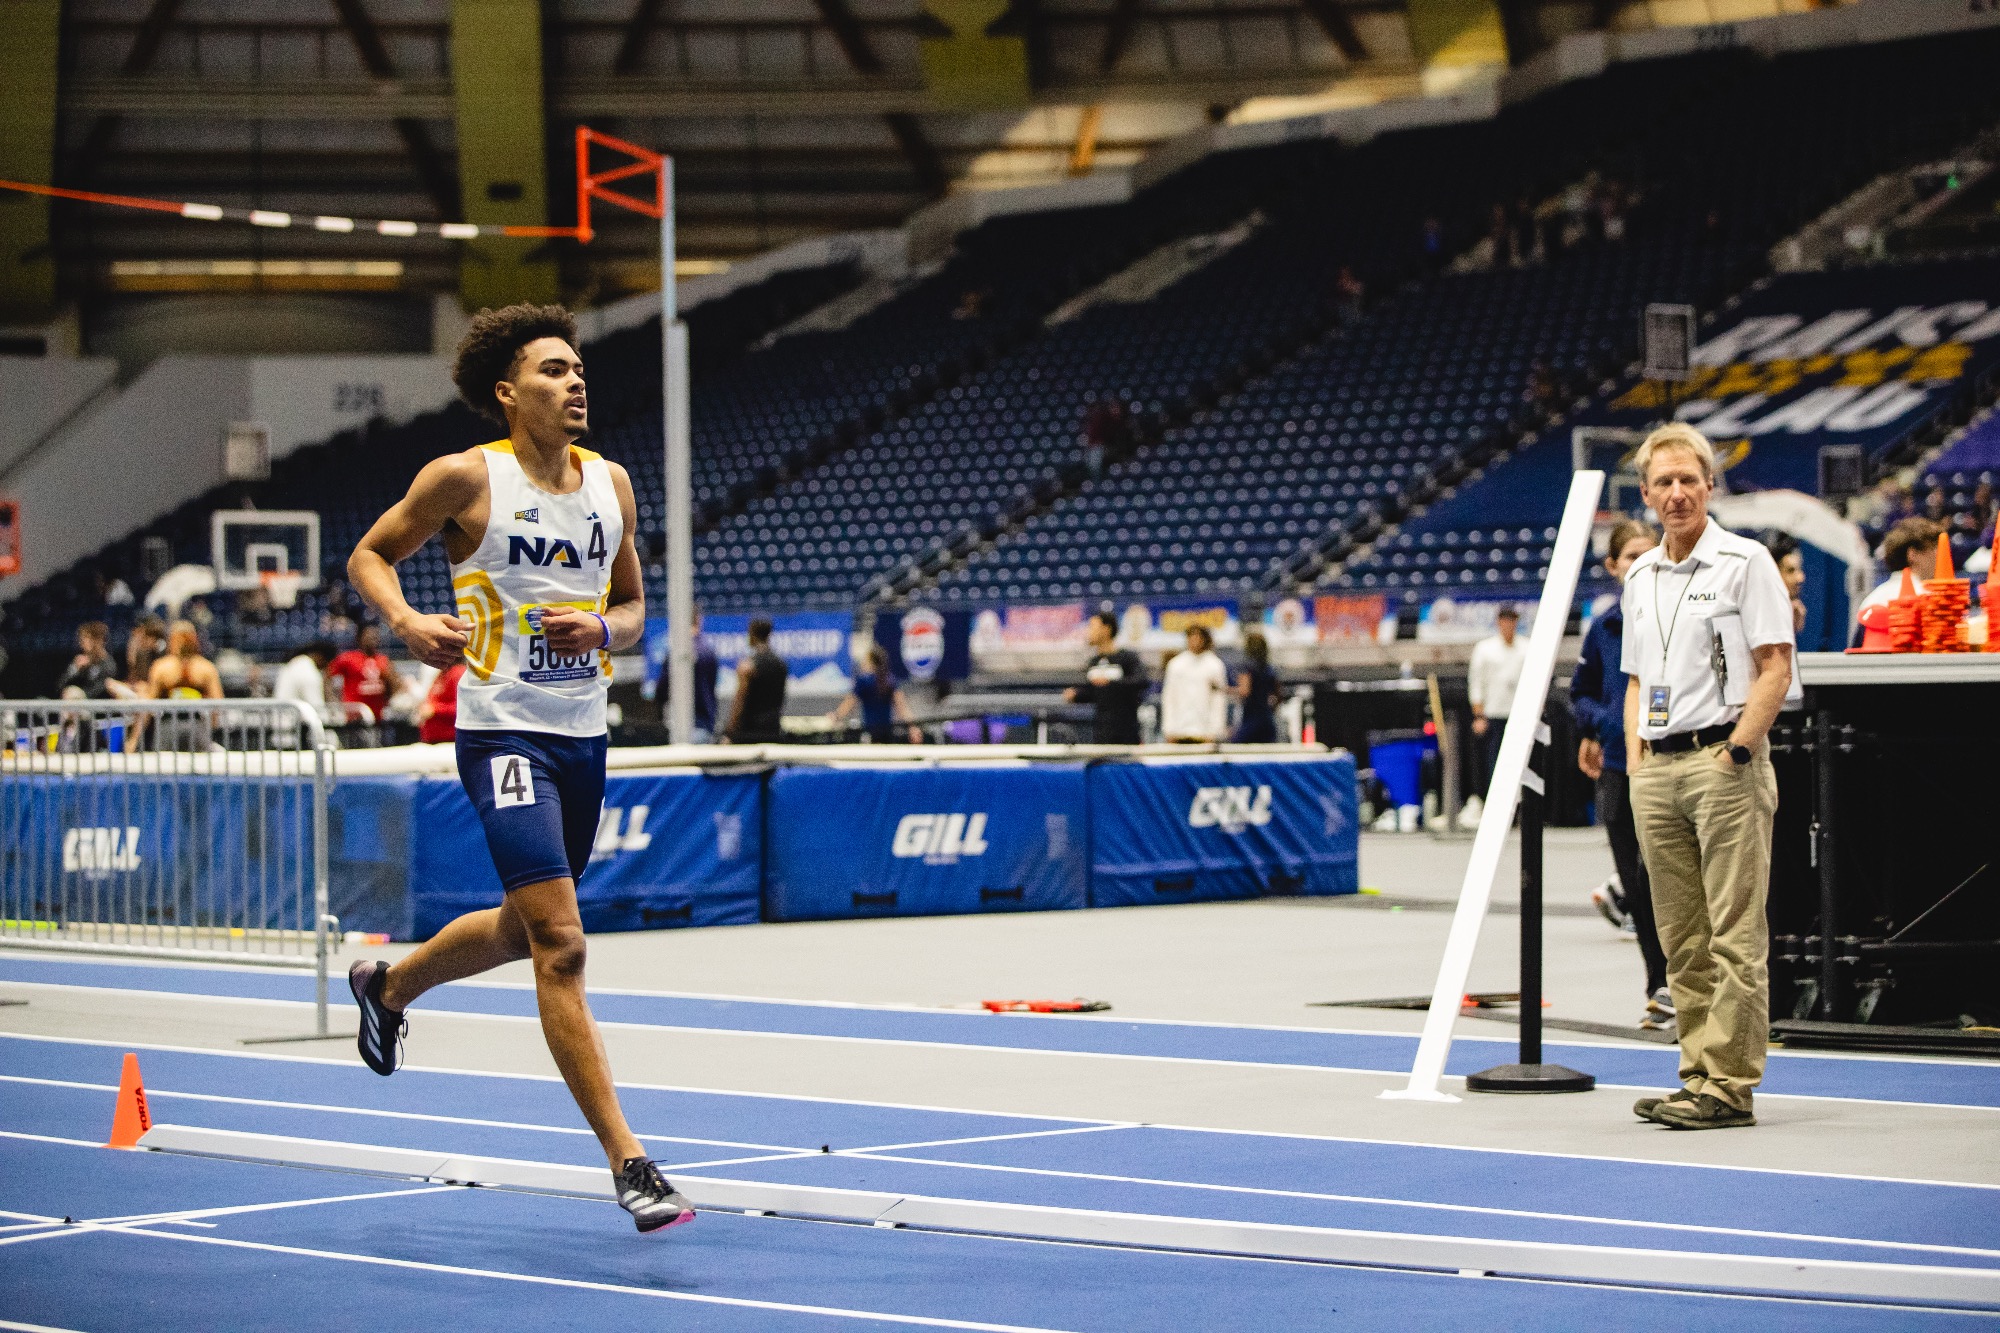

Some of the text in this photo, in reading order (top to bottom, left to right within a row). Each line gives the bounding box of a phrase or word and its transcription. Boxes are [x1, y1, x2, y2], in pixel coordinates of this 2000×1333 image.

[508, 536, 583, 568] NA
[588, 521, 607, 567] 4
[1688, 592, 1716, 601] NAU
[501, 758, 527, 801] 4
[63, 827, 141, 872] GILL
[597, 805, 652, 850] LL
[892, 812, 989, 857] GILL
[135, 1087, 149, 1132] FORZA
